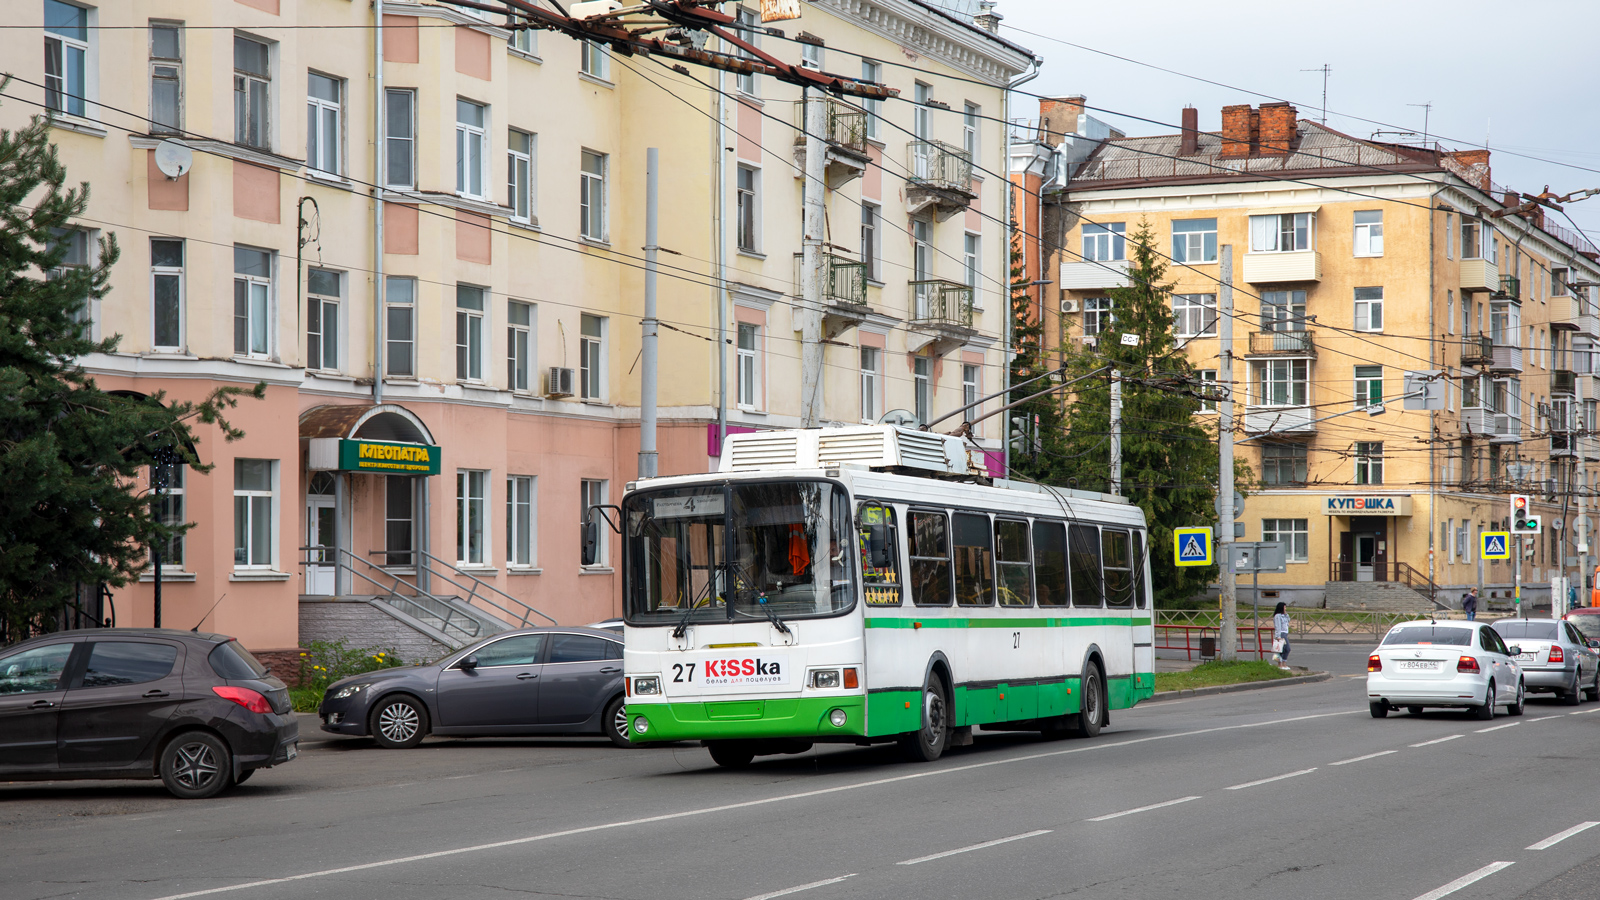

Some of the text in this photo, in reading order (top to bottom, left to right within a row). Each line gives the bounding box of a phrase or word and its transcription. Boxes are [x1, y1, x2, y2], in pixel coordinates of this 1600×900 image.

[359, 443, 430, 462] КЛЕОПАТРА
[683, 497, 696, 512] 4
[1328, 498, 1394, 509] КУПЭШКА
[1012, 631, 1021, 649] 27
[672, 663, 696, 683] 27
[745, 676, 781, 684] поцелуев
